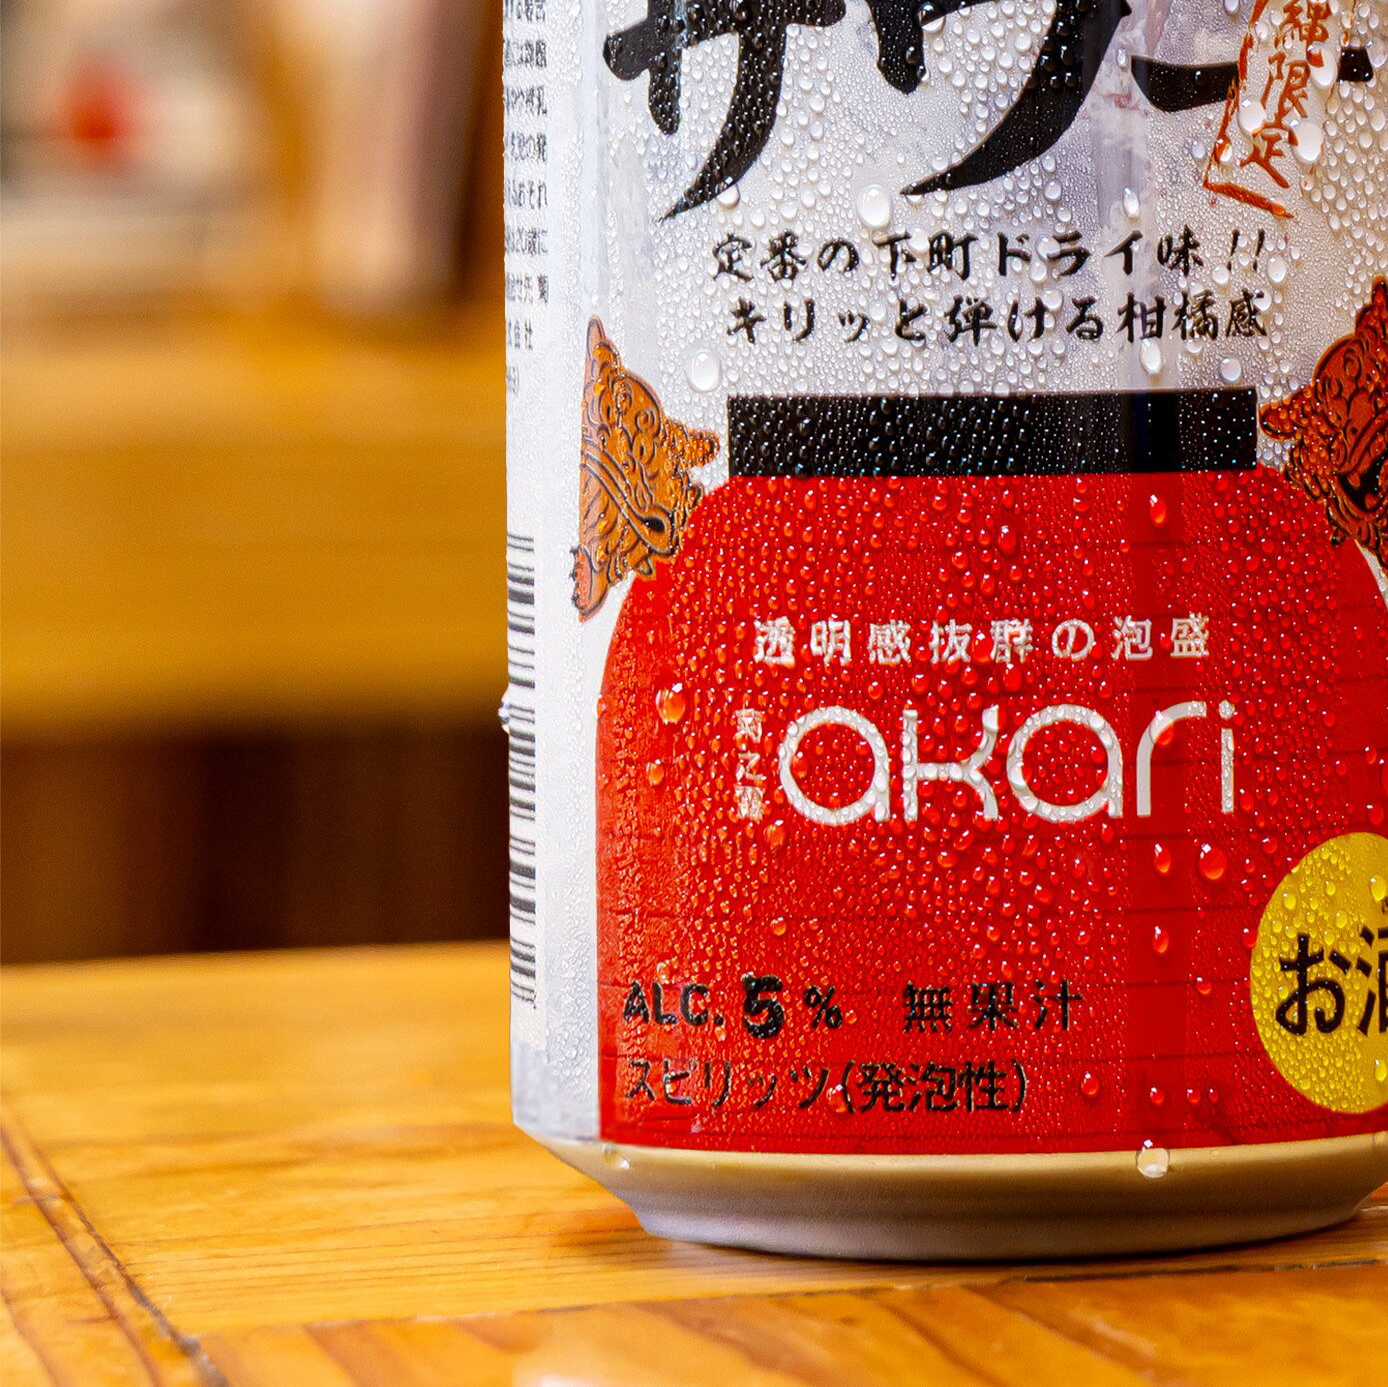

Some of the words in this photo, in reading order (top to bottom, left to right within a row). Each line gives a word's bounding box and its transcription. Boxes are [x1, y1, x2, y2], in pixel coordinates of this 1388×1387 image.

[727, 288, 1268, 347] キリッと弾ける柑橘感
[753, 611, 1209, 669] 透明感抜群の泡盛
[778, 698, 1236, 827] akari
[623, 979, 726, 1027] ALC.
[902, 978, 1085, 1033] 無果汁
[626, 1058, 1027, 1115] スピリッツ(発泡性)
